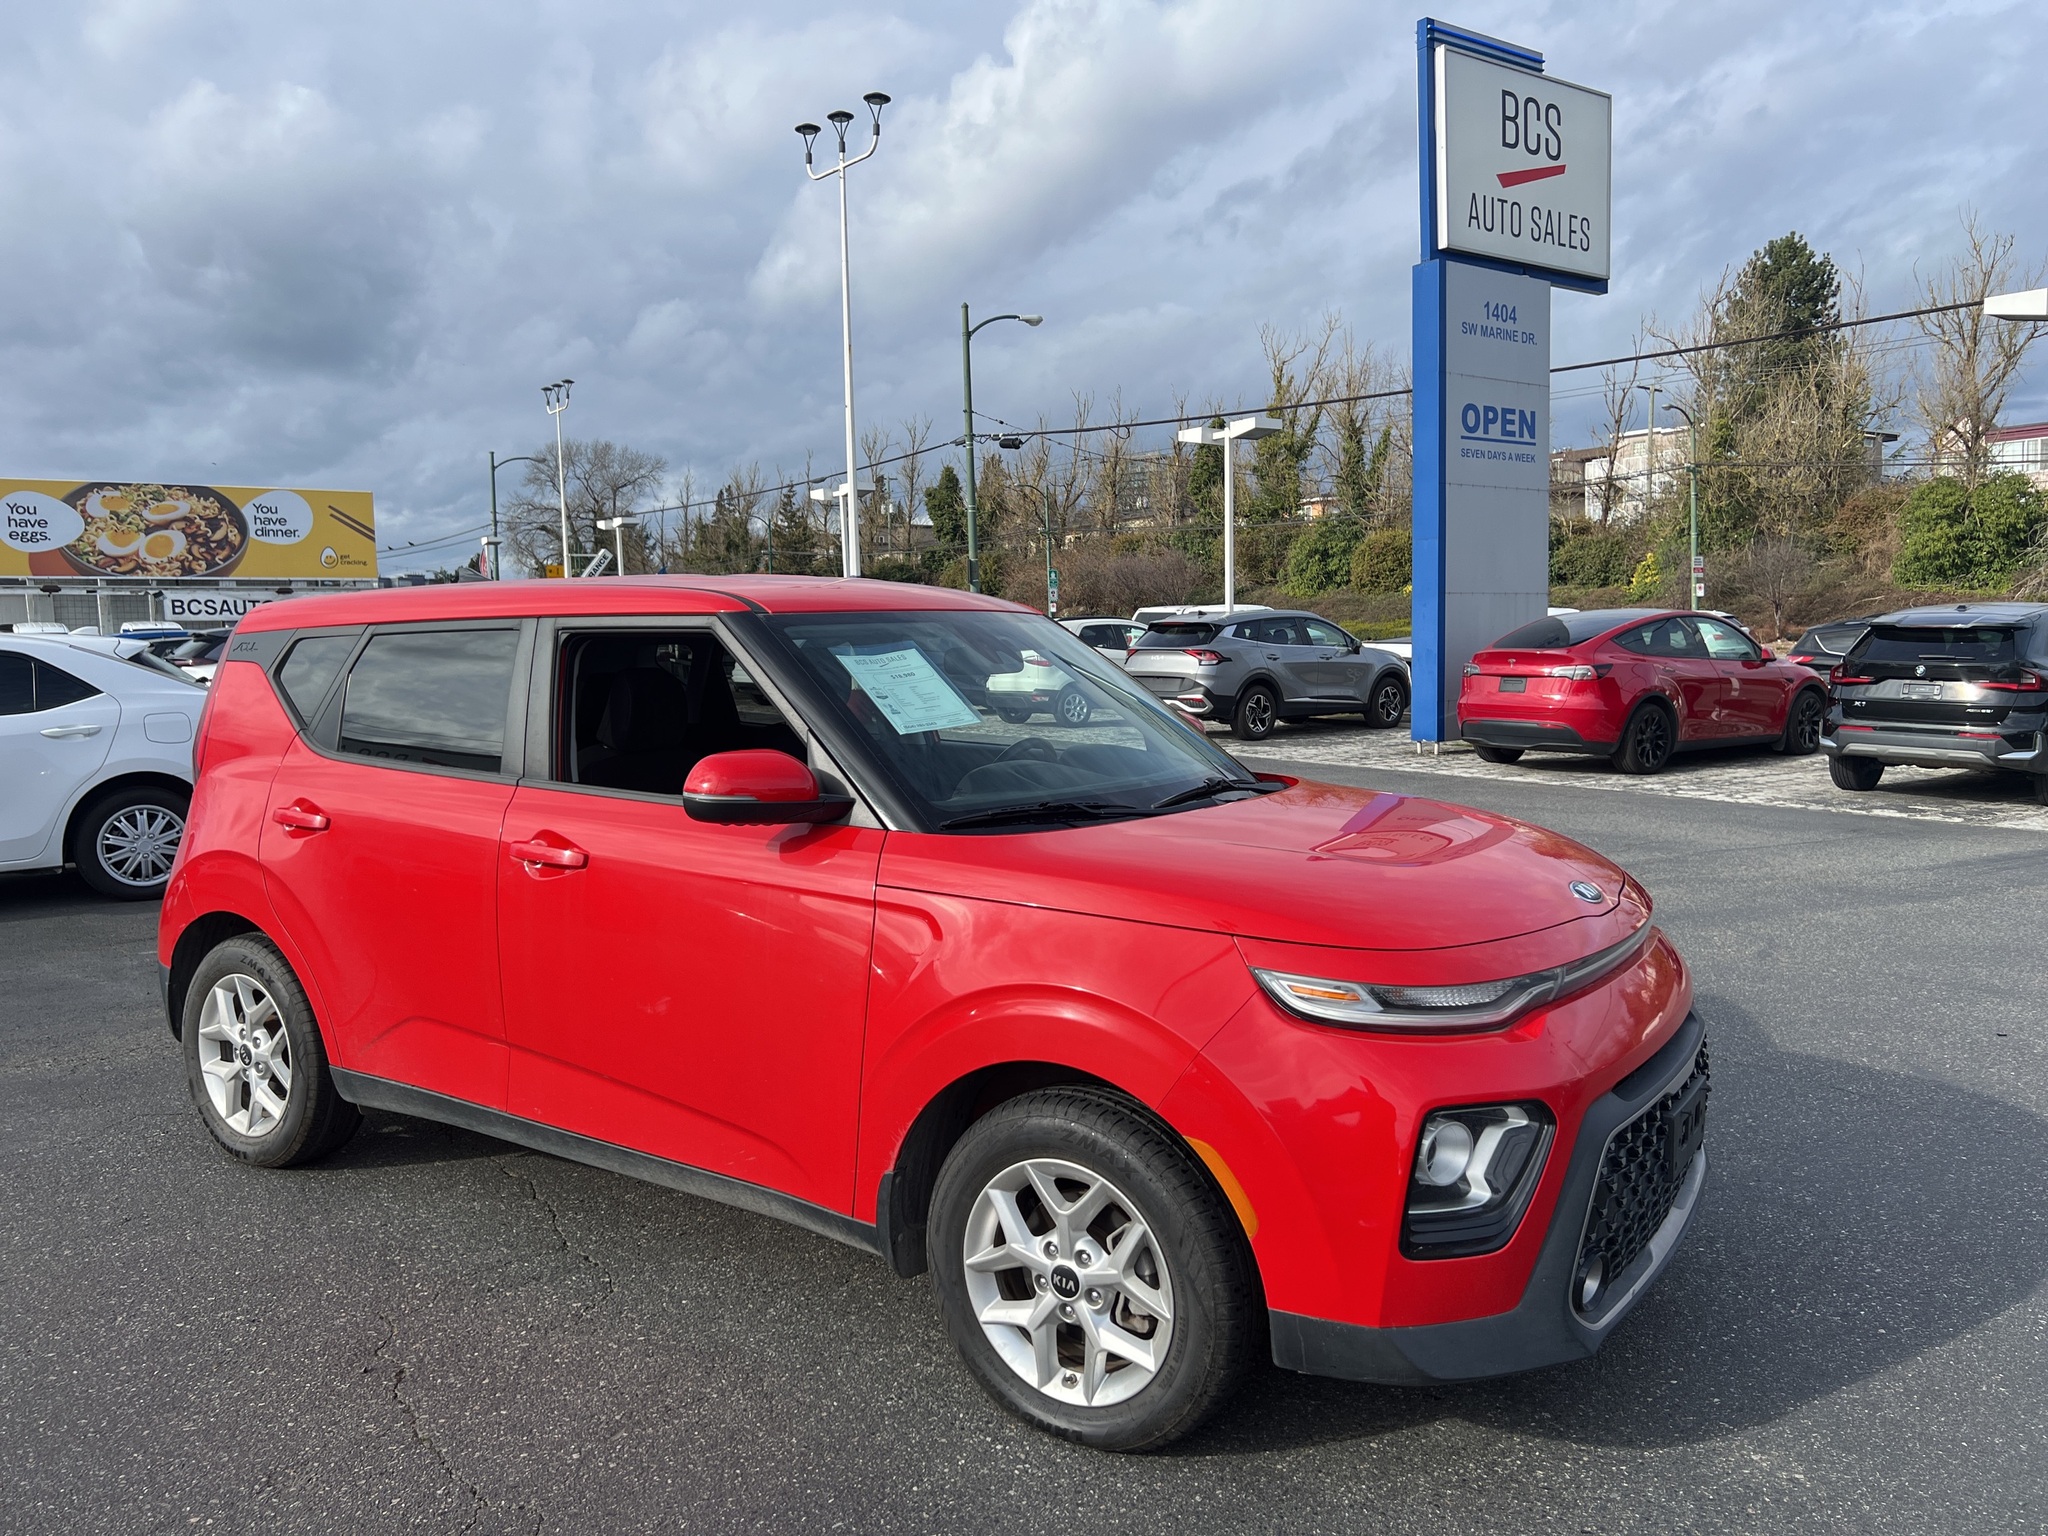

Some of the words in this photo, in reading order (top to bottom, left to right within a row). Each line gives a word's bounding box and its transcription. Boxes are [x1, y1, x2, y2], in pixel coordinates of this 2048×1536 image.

[1501, 89, 1562, 161] BCS
[1468, 192, 1522, 238] AUTO
[1530, 206, 1591, 252] SALES
[1483, 300, 1518, 325] 1404
[1461, 321, 1478, 336] SW
[1480, 324, 1519, 343] MARINE
[1521, 331, 1538, 346] DR.
[1461, 402, 1536, 440] OPEN
[1460, 447, 1486, 459] SEVEN
[1487, 450, 1507, 461] DAYS
[1507, 452, 1514, 462] A
[1514, 453, 1536, 463] WEEK
[6, 502, 37, 515] You
[252, 503, 278, 515] You
[7, 516, 48, 528] have
[254, 515, 287, 526] have
[8, 530, 51, 543] eggs.
[254, 526, 300, 538] dinner.
[171, 599, 274, 616] BCSAUT
[240, 954, 275, 986] ZMAX
[1060, 1128, 1140, 1180] ZMAX
[1053, 1273, 1075, 1292] KIA
